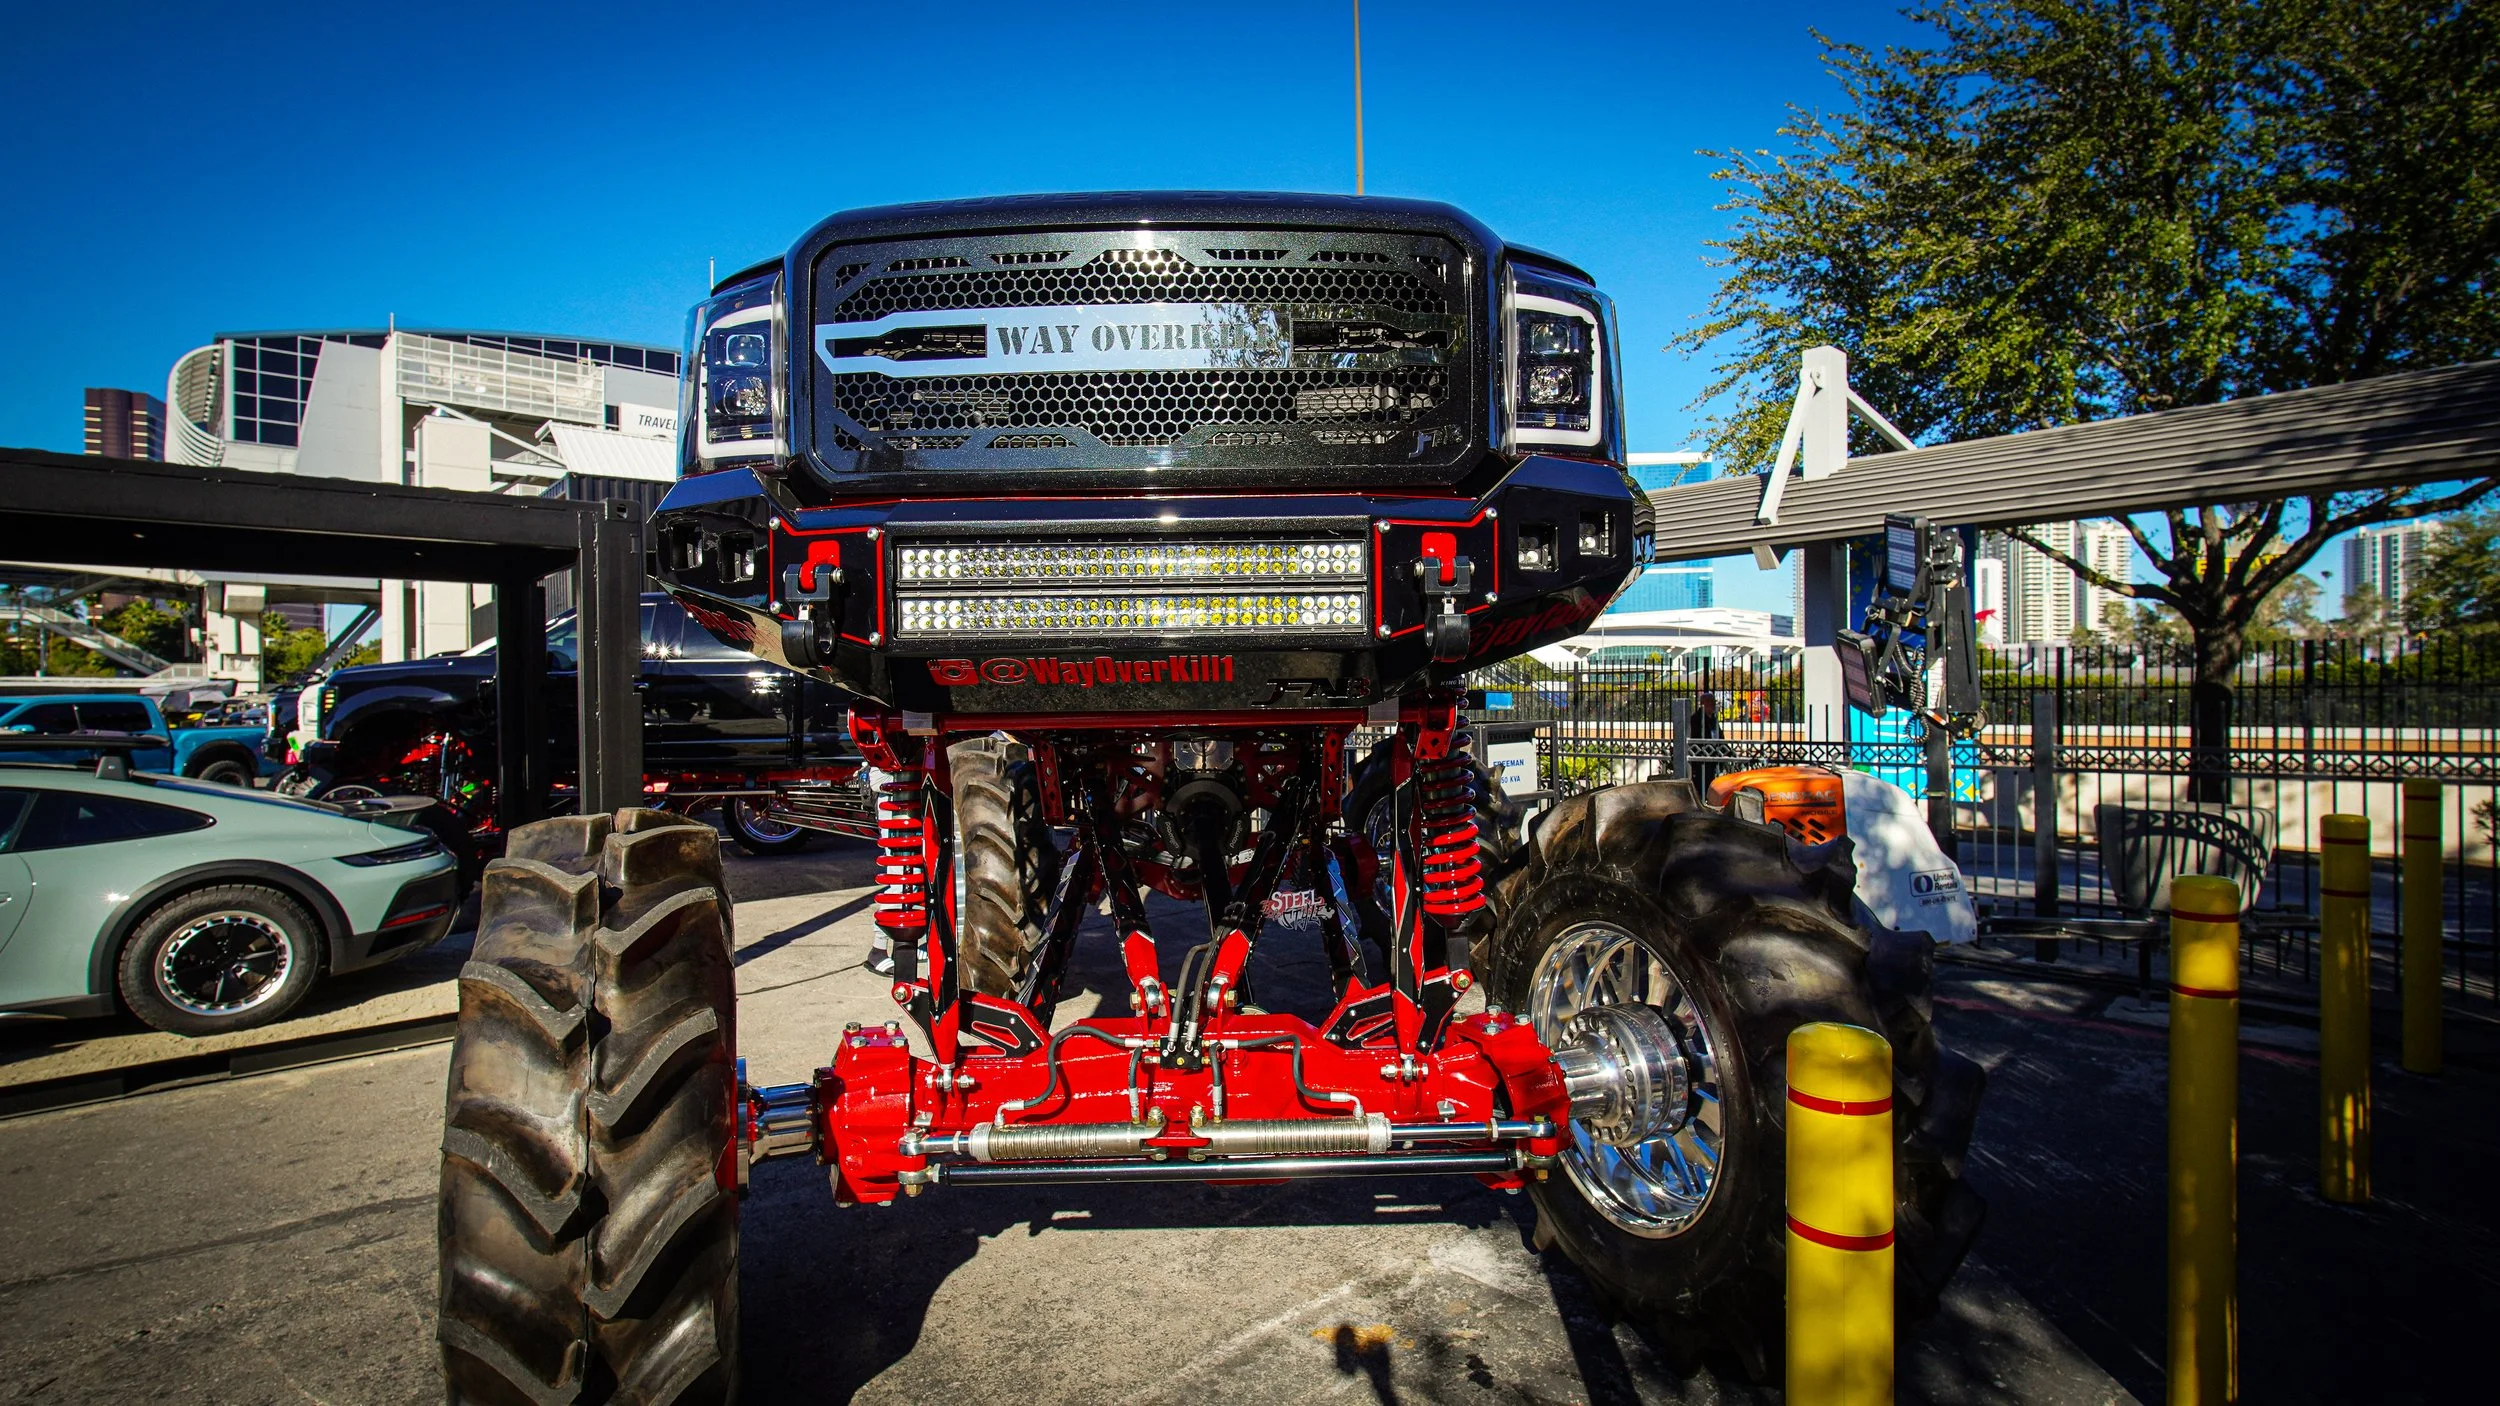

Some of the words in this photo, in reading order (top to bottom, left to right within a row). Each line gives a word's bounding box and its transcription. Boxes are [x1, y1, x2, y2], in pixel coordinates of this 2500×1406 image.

[996, 325, 1079, 355] WAY
[1091, 322, 1279, 351] OVERKILL
[639, 414, 677, 430] TRAVEL
[979, 655, 1234, 689] @WayOverKill1
[1933, 872, 1954, 881] United
[1271, 889, 1321, 911] STEEL
